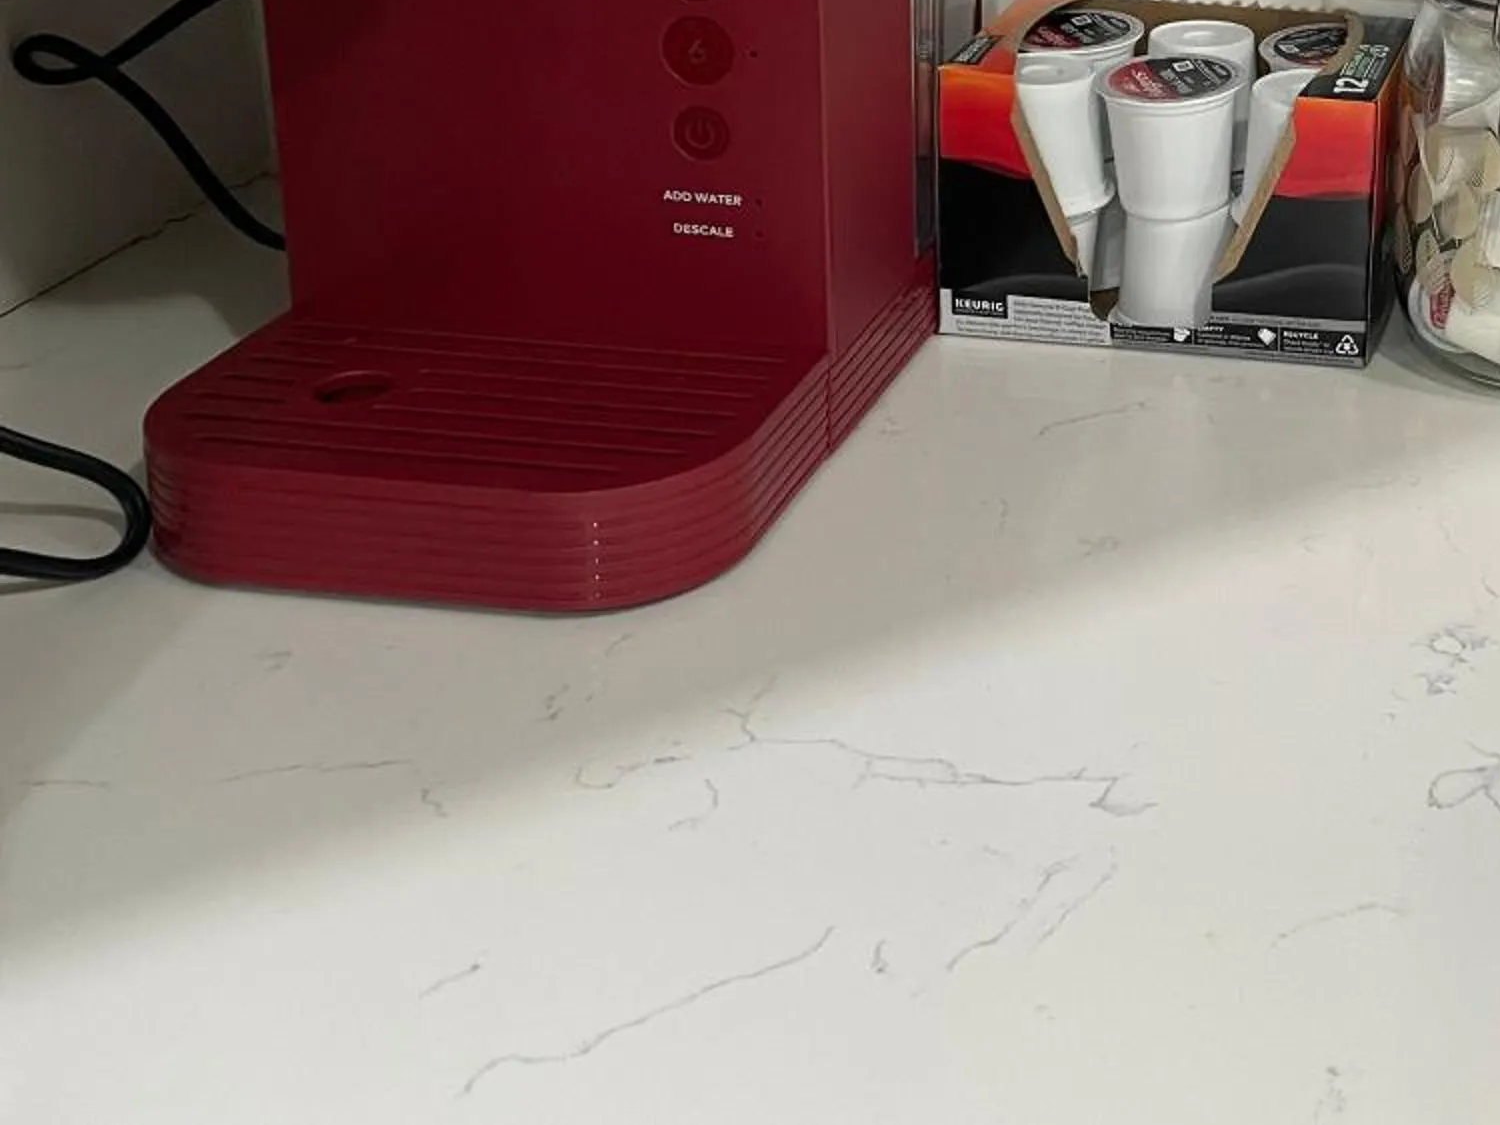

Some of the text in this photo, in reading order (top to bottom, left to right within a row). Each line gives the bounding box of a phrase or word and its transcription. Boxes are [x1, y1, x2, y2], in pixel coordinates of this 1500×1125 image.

[688, 38, 706, 65] 6
[663, 190, 743, 207] ADD WATER
[673, 222, 734, 238] DESCALE
[955, 297, 1006, 313] KEURIG
